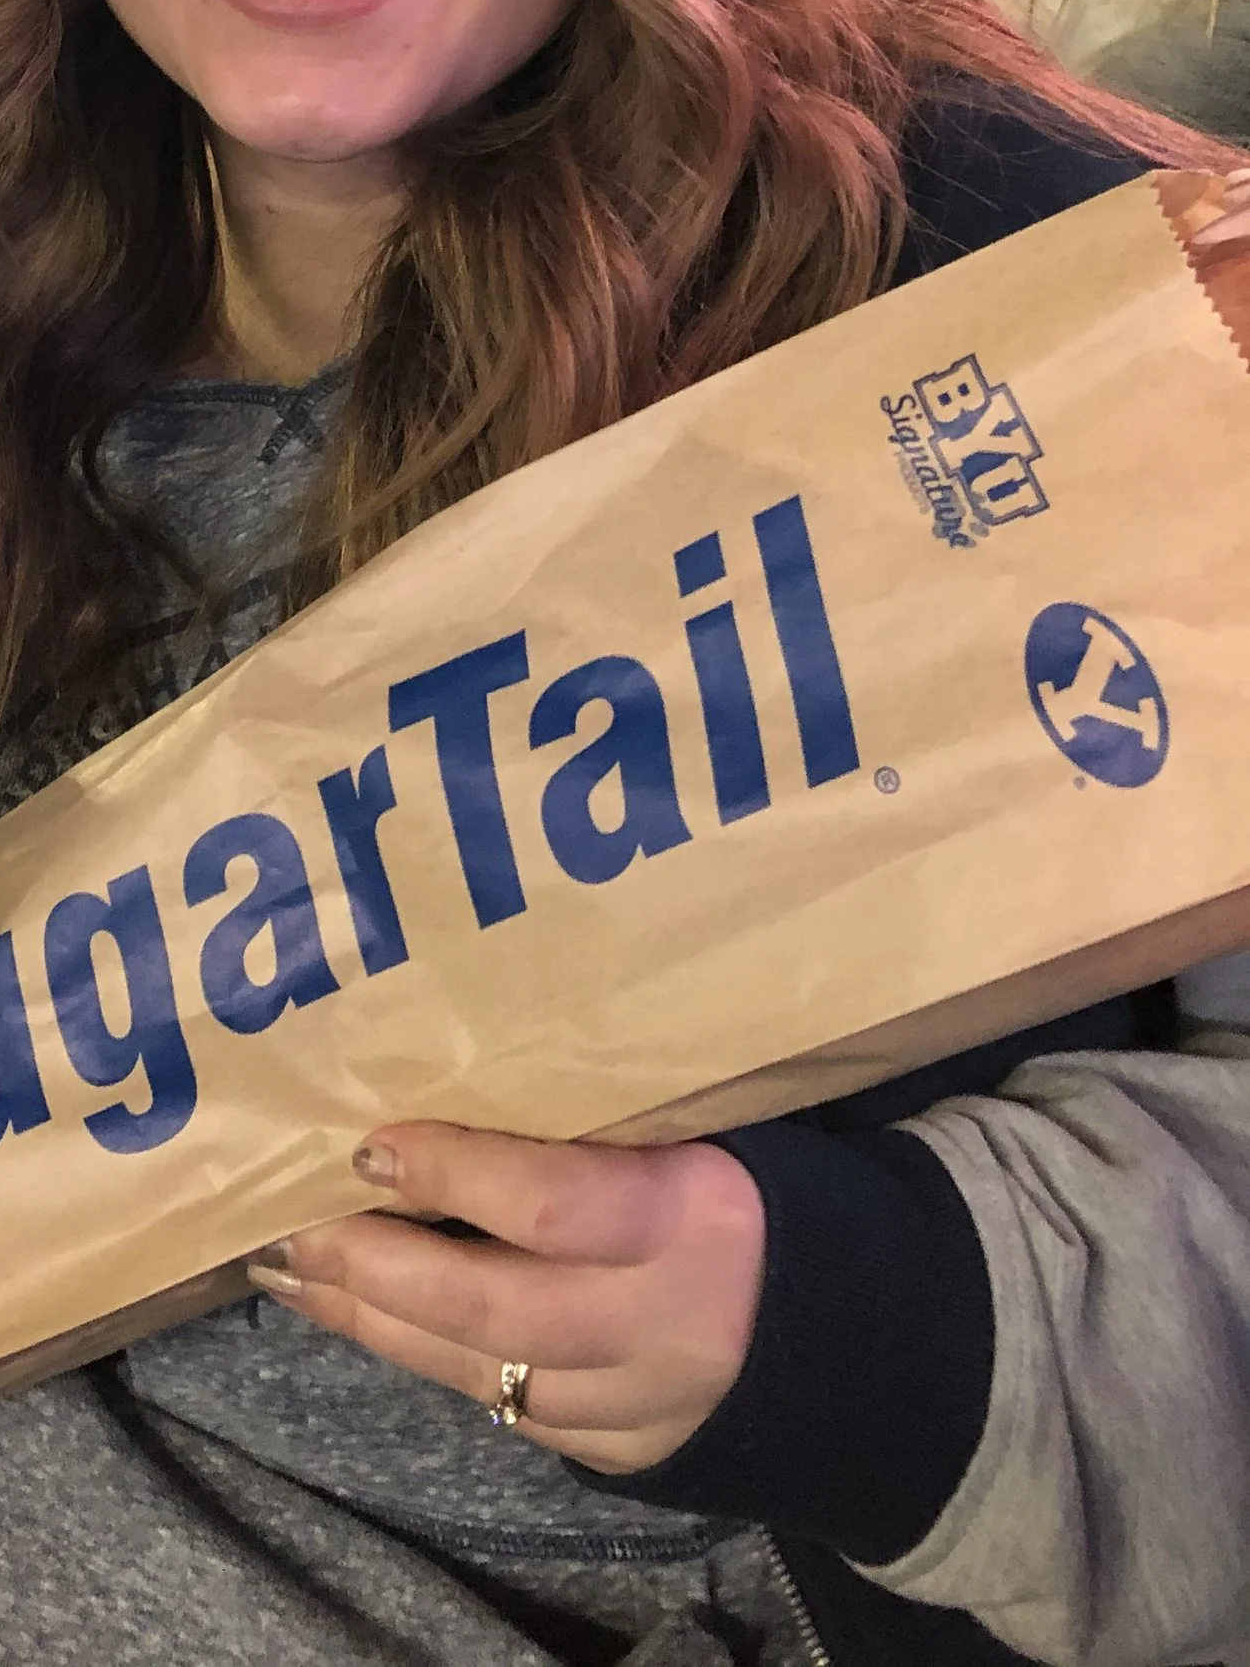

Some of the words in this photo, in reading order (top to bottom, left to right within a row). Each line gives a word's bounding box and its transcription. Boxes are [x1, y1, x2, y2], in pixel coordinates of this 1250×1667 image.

[880, 394, 975, 548] Signature
[912, 352, 1050, 526] BYU
[1037, 616, 1162, 751] Y
